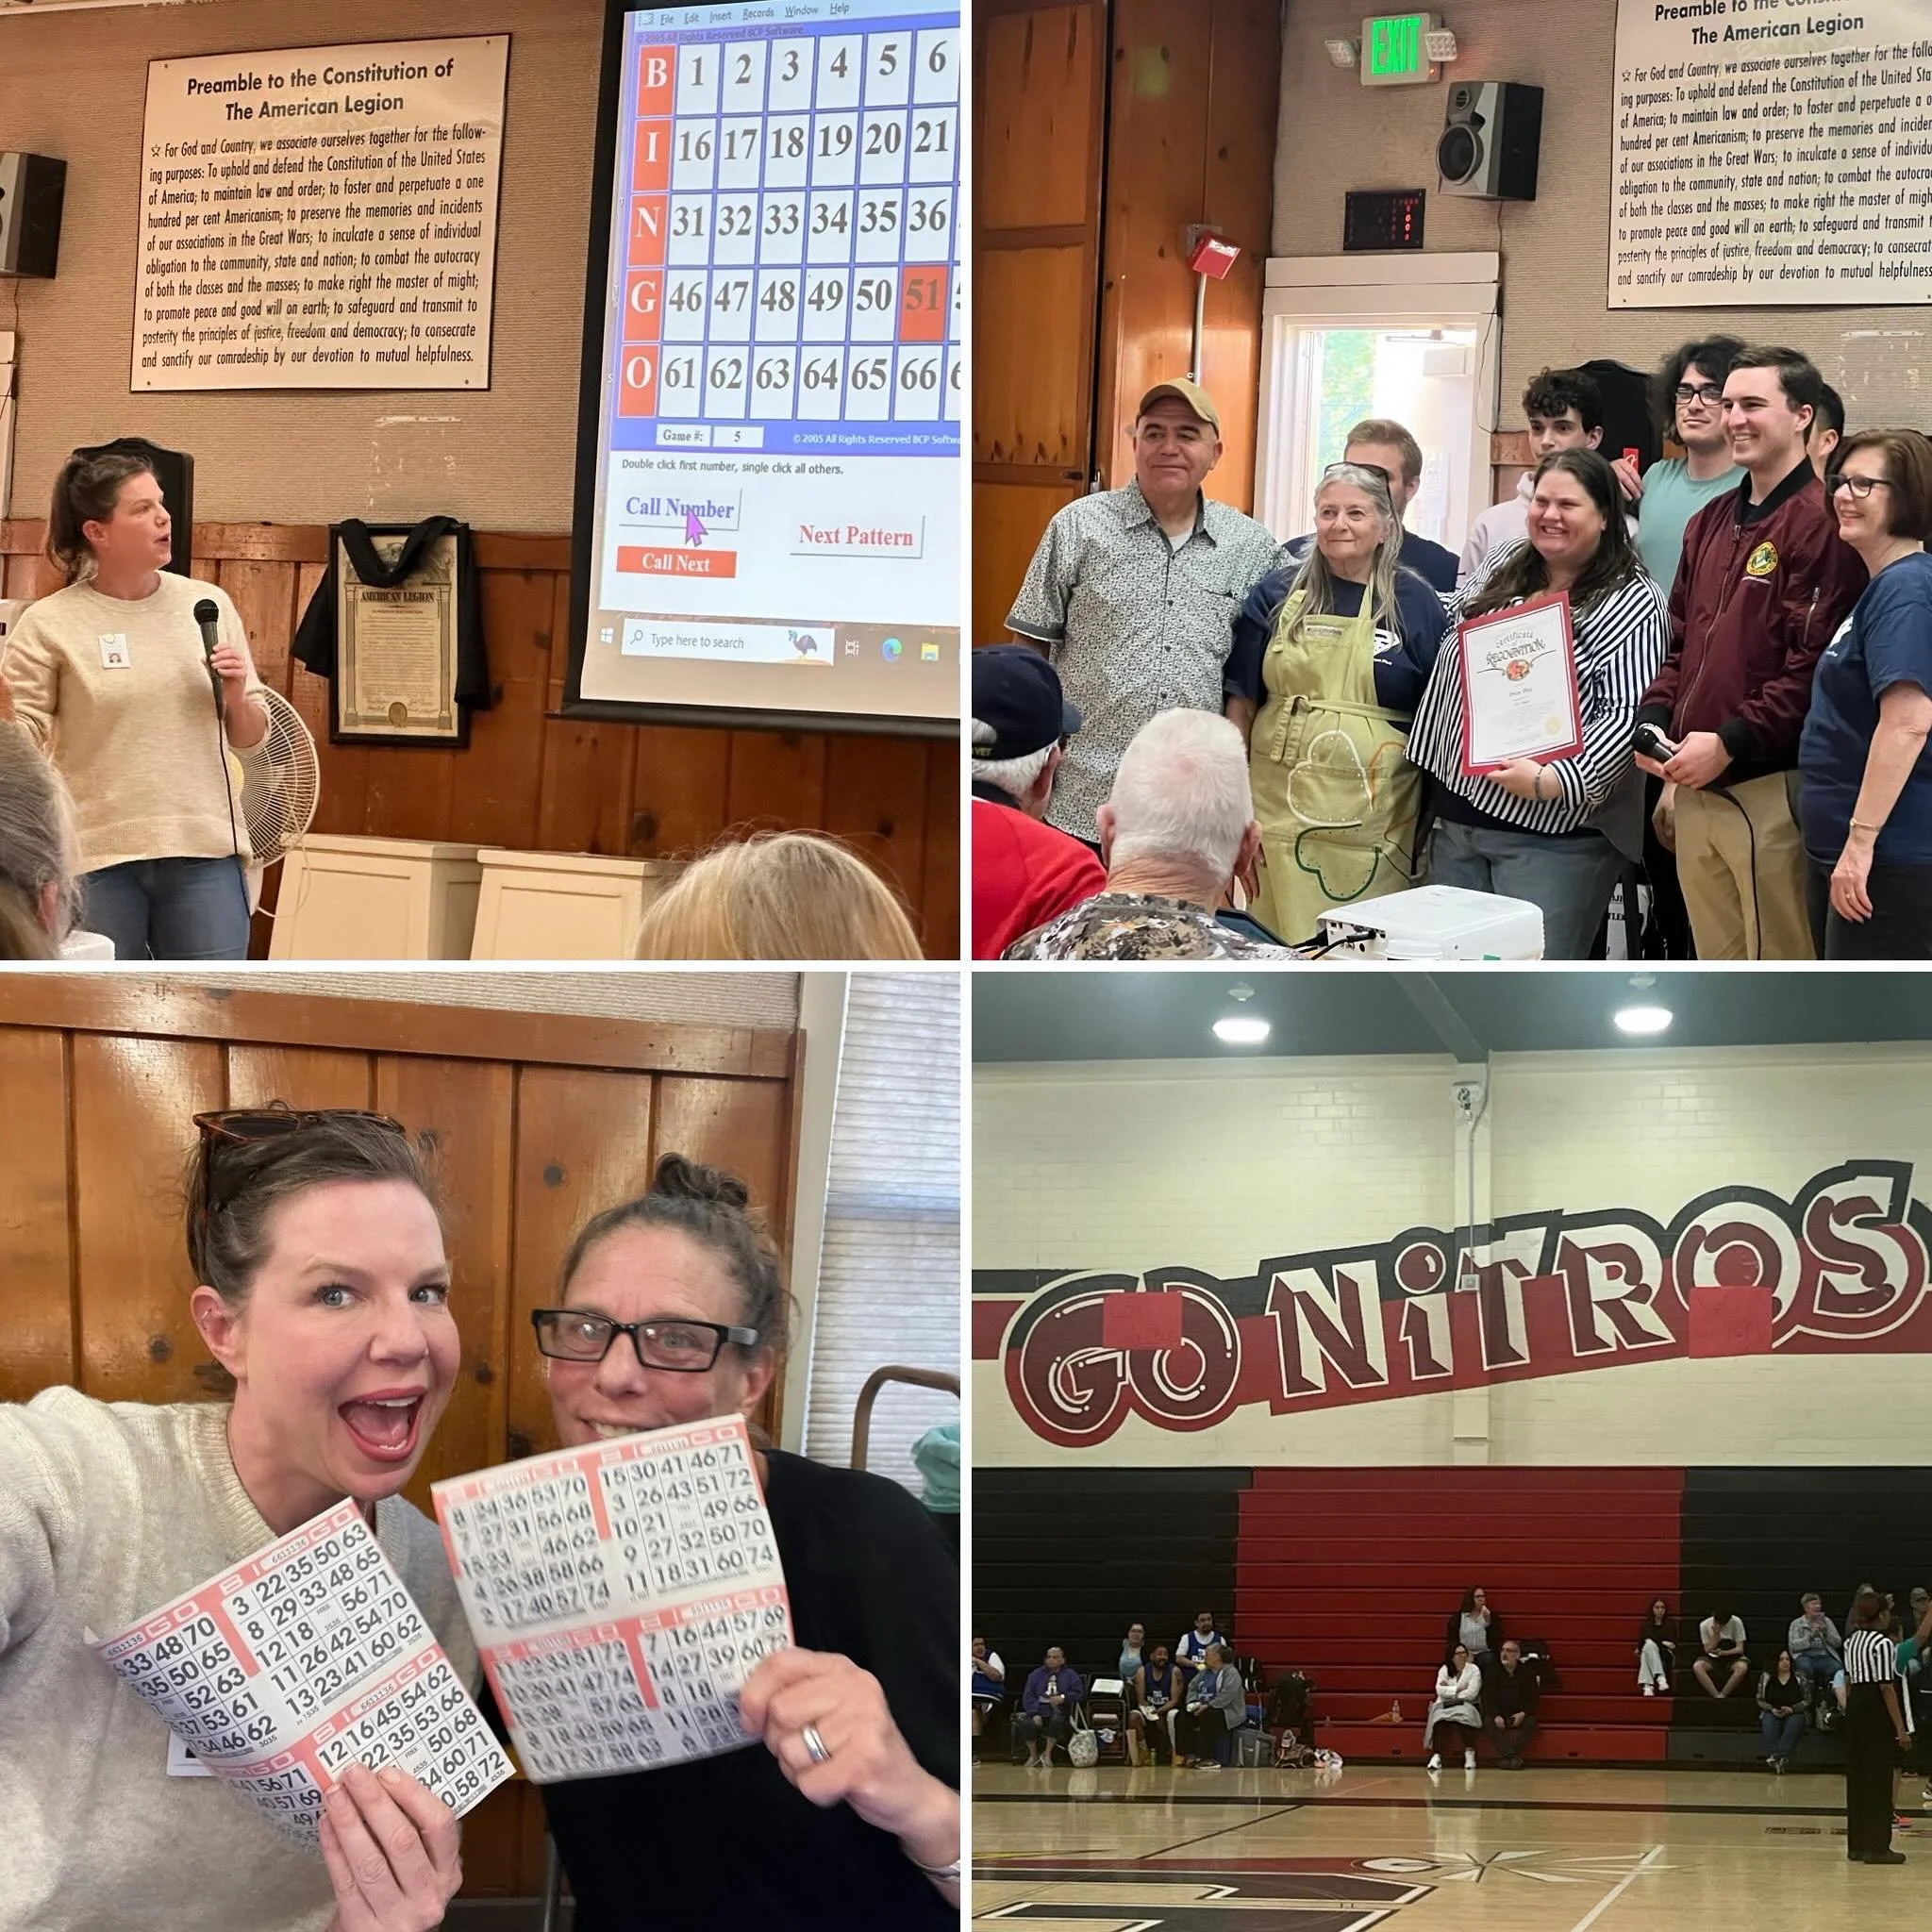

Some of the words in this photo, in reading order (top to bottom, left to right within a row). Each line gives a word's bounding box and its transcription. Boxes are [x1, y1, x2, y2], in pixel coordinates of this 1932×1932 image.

[660, 13, 674, 25] File
[684, 13, 699, 24] Edit
[709, 10, 732, 23] Insert
[742, 8, 774, 21] Records
[785, 5, 819, 17] Window
[830, 2, 850, 14] Help
[1655, 0, 1725, 21] Preamble
[1691, 27, 1718, 45] The
[1724, 22, 1800, 42] American
[1807, 14, 1864, 35] Legion
[1373, 17, 1421, 75] EXIT
[188, 73, 262, 95] Preamble
[268, 74, 284, 90] to
[291, 69, 317, 87] the
[324, 61, 427, 86] Constitution
[435, 58, 454, 77] of
[644, 56, 669, 90] B
[690, 56, 705, 87] 1
[734, 52, 752, 85] 2
[781, 49, 800, 82] 3
[830, 47, 848, 79] 4
[878, 43, 897, 76] 5
[928, 40, 948, 74] 6
[225, 103, 253, 121] The
[258, 97, 338, 119] American
[345, 92, 404, 114] Legion
[165, 143, 177, 158] For
[181, 141, 197, 156] God
[201, 141, 216, 156] and
[259, 138, 273, 152] we
[276, 136, 317, 150] associate
[321, 131, 365, 147] ourselves
[369, 130, 409, 147] together
[413, 126, 428, 142] for
[432, 125, 447, 142] the
[647, 130, 658, 162] I
[678, 130, 712, 162] 16
[724, 128, 757, 160] 17
[770, 126, 805, 158] 18
[819, 125, 853, 157] 19
[866, 122, 902, 156] 20
[914, 119, 950, 153] 21
[1620, 135, 1652, 151] hundred
[1656, 137, 1668, 149] per
[1673, 135, 1689, 148] cent
[1752, 129, 1761, 142] to
[1766, 126, 1805, 142] preserve
[1809, 125, 1824, 139] the
[1828, 124, 1874, 138] memories
[1878, 121, 1895, 135] and
[634, 206, 661, 239] N
[673, 206, 706, 238] 31
[717, 205, 753, 236] 32
[764, 204, 800, 235] 33
[811, 202, 849, 234] 34
[860, 200, 898, 233] 35
[908, 199, 948, 232] 36
[1618, 273, 1632, 286] and
[1637, 271, 1666, 287] sanctify
[1671, 272, 1684, 283] our
[1688, 270, 1738, 284] comradeship
[1742, 268, 1753, 283] by
[1759, 268, 1774, 281] our
[1779, 265, 1820, 280] devotion
[1825, 265, 1835, 278] to
[1840, 264, 1874, 278] mutual
[630, 280, 657, 313] G
[669, 281, 703, 312] 46
[714, 281, 749, 312] 47
[760, 280, 796, 312] 48
[808, 279, 844, 311] 49
[857, 278, 893, 311] 50
[906, 278, 941, 311] 51
[142, 354, 157, 368] and
[161, 352, 193, 369] sanctify
[198, 353, 211, 366] our
[216, 351, 269, 367] comradeship
[274, 348, 285, 366] by
[291, 350, 306, 363] our
[312, 348, 354, 362] devotion
[359, 348, 370, 362] to
[375, 347, 409, 362] mutual
[626, 357, 652, 389] O
[664, 358, 696, 389] 61
[709, 358, 743, 390] 62
[756, 358, 791, 390] 63
[804, 358, 839, 390] 64
[852, 358, 888, 391] 65
[900, 358, 939, 391] 66
[663, 430, 691, 442] Game
[693, 431, 704, 442] #:
[734, 431, 741, 443] 5
[622, 458, 654, 471] Double
[658, 458, 675, 472] click
[679, 458, 696, 473] first
[700, 460, 738, 475] number,
[741, 460, 768, 475] single
[772, 462, 791, 474] click
[795, 462, 806, 475] all
[808, 462, 843, 475] others.
[625, 496, 661, 516] Call
[666, 497, 735, 519] Number
[799, 525, 840, 545] Next
[847, 525, 913, 547] Pattern
[642, 554, 672, 571] Call
[675, 555, 710, 573] Next
[652, 633, 672, 649] Type
[675, 633, 697, 648] here
[700, 635, 710, 648] to
[713, 635, 744, 650] search
[1009, 1275, 1243, 1443] GO
[232, 1596, 250, 1616] 3
[256, 1574, 286, 1602] 22
[285, 1557, 313, 1585] 35
[313, 1540, 341, 1566] 50
[341, 1524, 368, 1549] 63
[247, 1622, 265, 1641] 8
[271, 1598, 298, 1626] 29
[298, 1580, 327, 1607] 33
[329, 1563, 355, 1590] 48
[357, 1545, 380, 1571] 65
[256, 1641, 287, 1668] 12
[285, 1623, 315, 1650] 18
[341, 1586, 368, 1612] 56
[368, 1570, 392, 1594] 71
[271, 1666, 297, 1692] 11
[300, 1645, 328, 1673] 26
[329, 1627, 358, 1654] 42
[355, 1610, 382, 1637] 54
[383, 1591, 408, 1617] 70
[286, 1689, 315, 1716] 13
[313, 1670, 342, 1697] 23
[343, 1651, 373, 1674] 41
[371, 1633, 396, 1659] 60
[397, 1614, 422, 1641] 62
